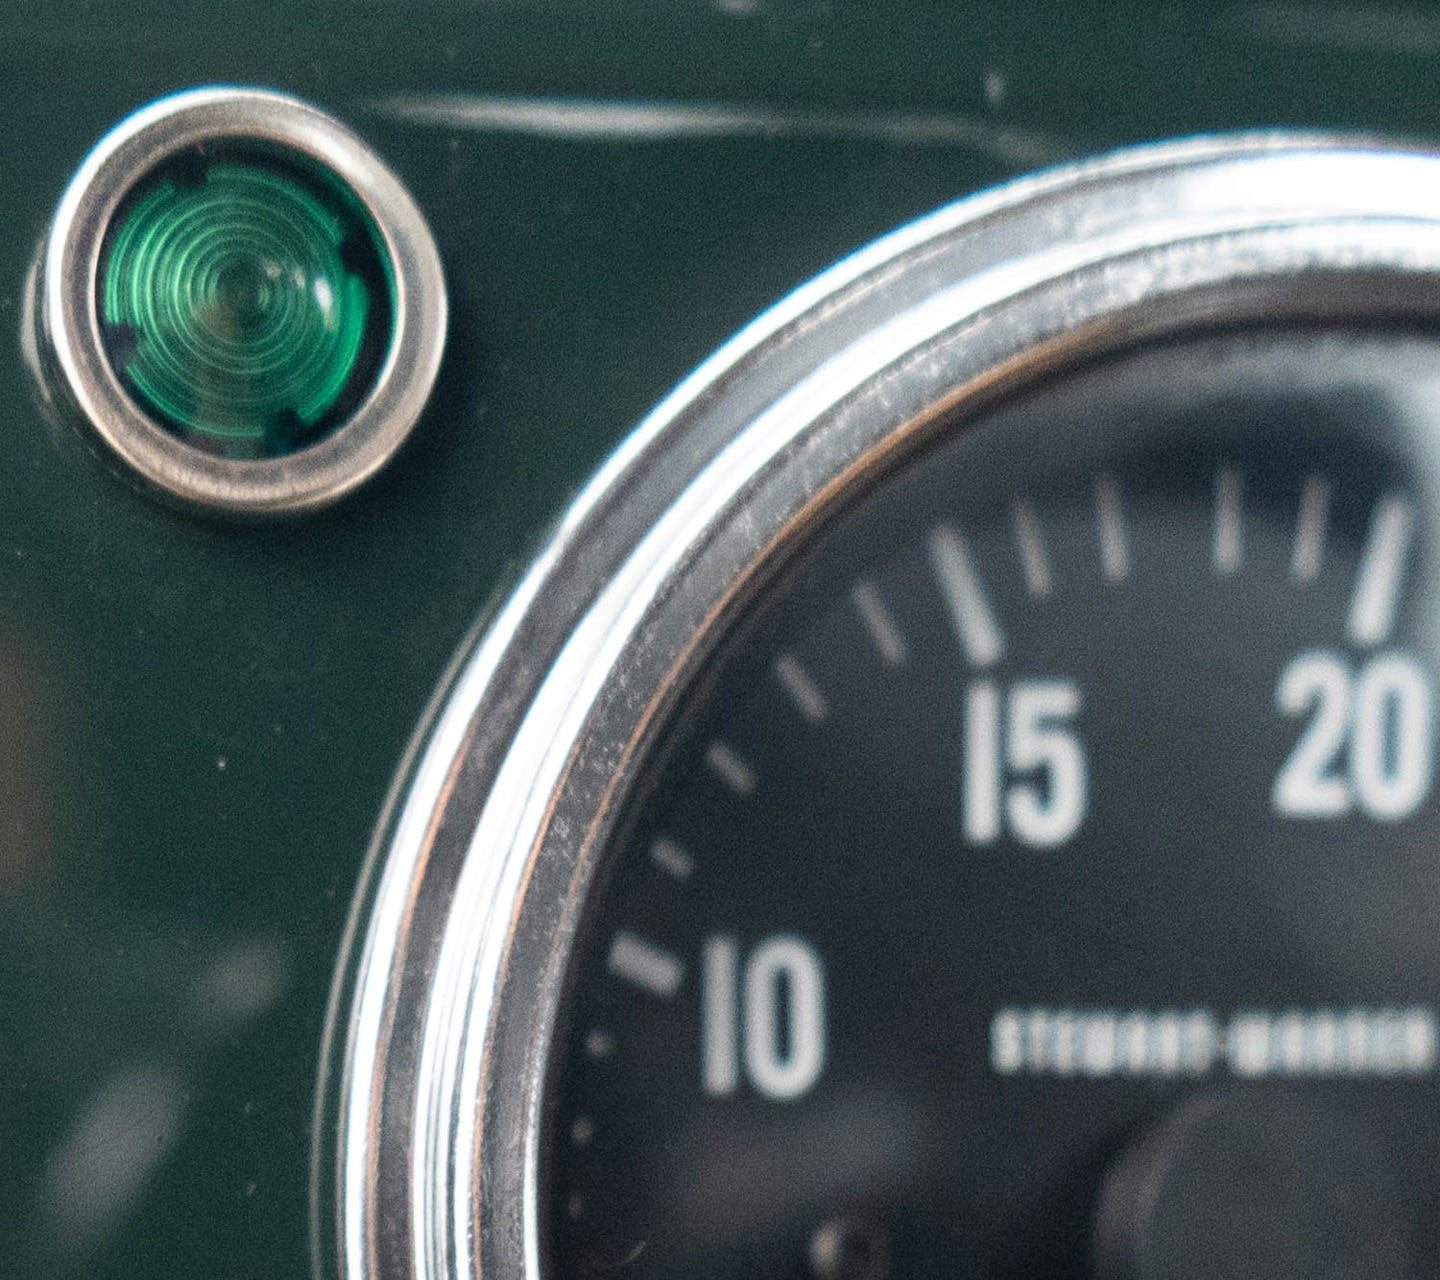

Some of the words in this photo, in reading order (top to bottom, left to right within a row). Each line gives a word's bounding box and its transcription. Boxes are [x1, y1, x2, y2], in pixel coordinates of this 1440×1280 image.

[962, 681, 1088, 846] 15
[1274, 652, 1434, 819] 20
[702, 934, 827, 1100] 10
[990, 1006, 1439, 1078] STEWART-WARNER
